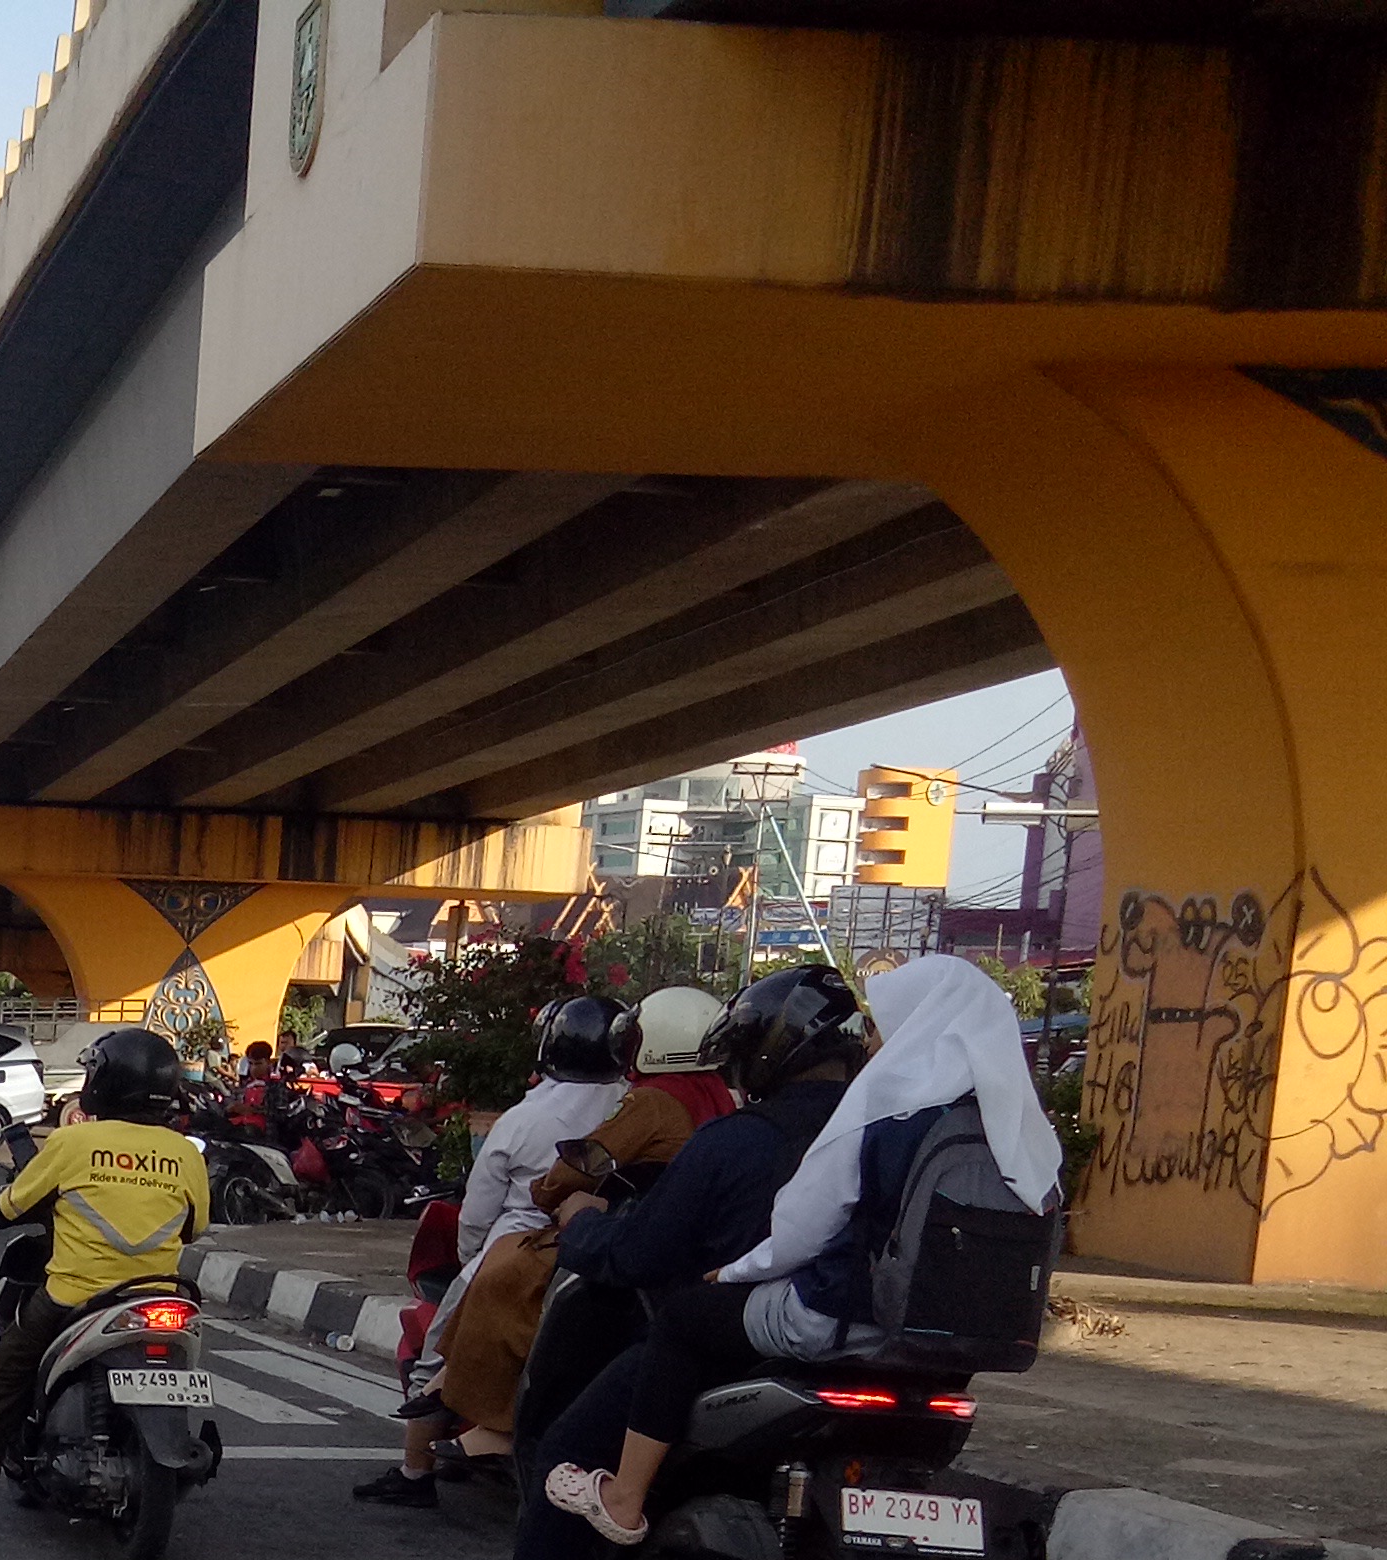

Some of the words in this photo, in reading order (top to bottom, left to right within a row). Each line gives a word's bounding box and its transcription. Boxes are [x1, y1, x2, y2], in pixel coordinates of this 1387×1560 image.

[91, 1149, 179, 1177] maxim
[89, 1173, 118, 1183] Rides
[120, 1176, 138, 1185] and
[140, 1178, 178, 1193] Delivery
[112, 1372, 134, 1386] BM
[138, 1372, 178, 1386] 2499
[848, 1494, 875, 1516] BM
[885, 1497, 939, 1521] 2349
[952, 1503, 978, 1526] YX
[851, 1536, 883, 1547] YAMAHA
